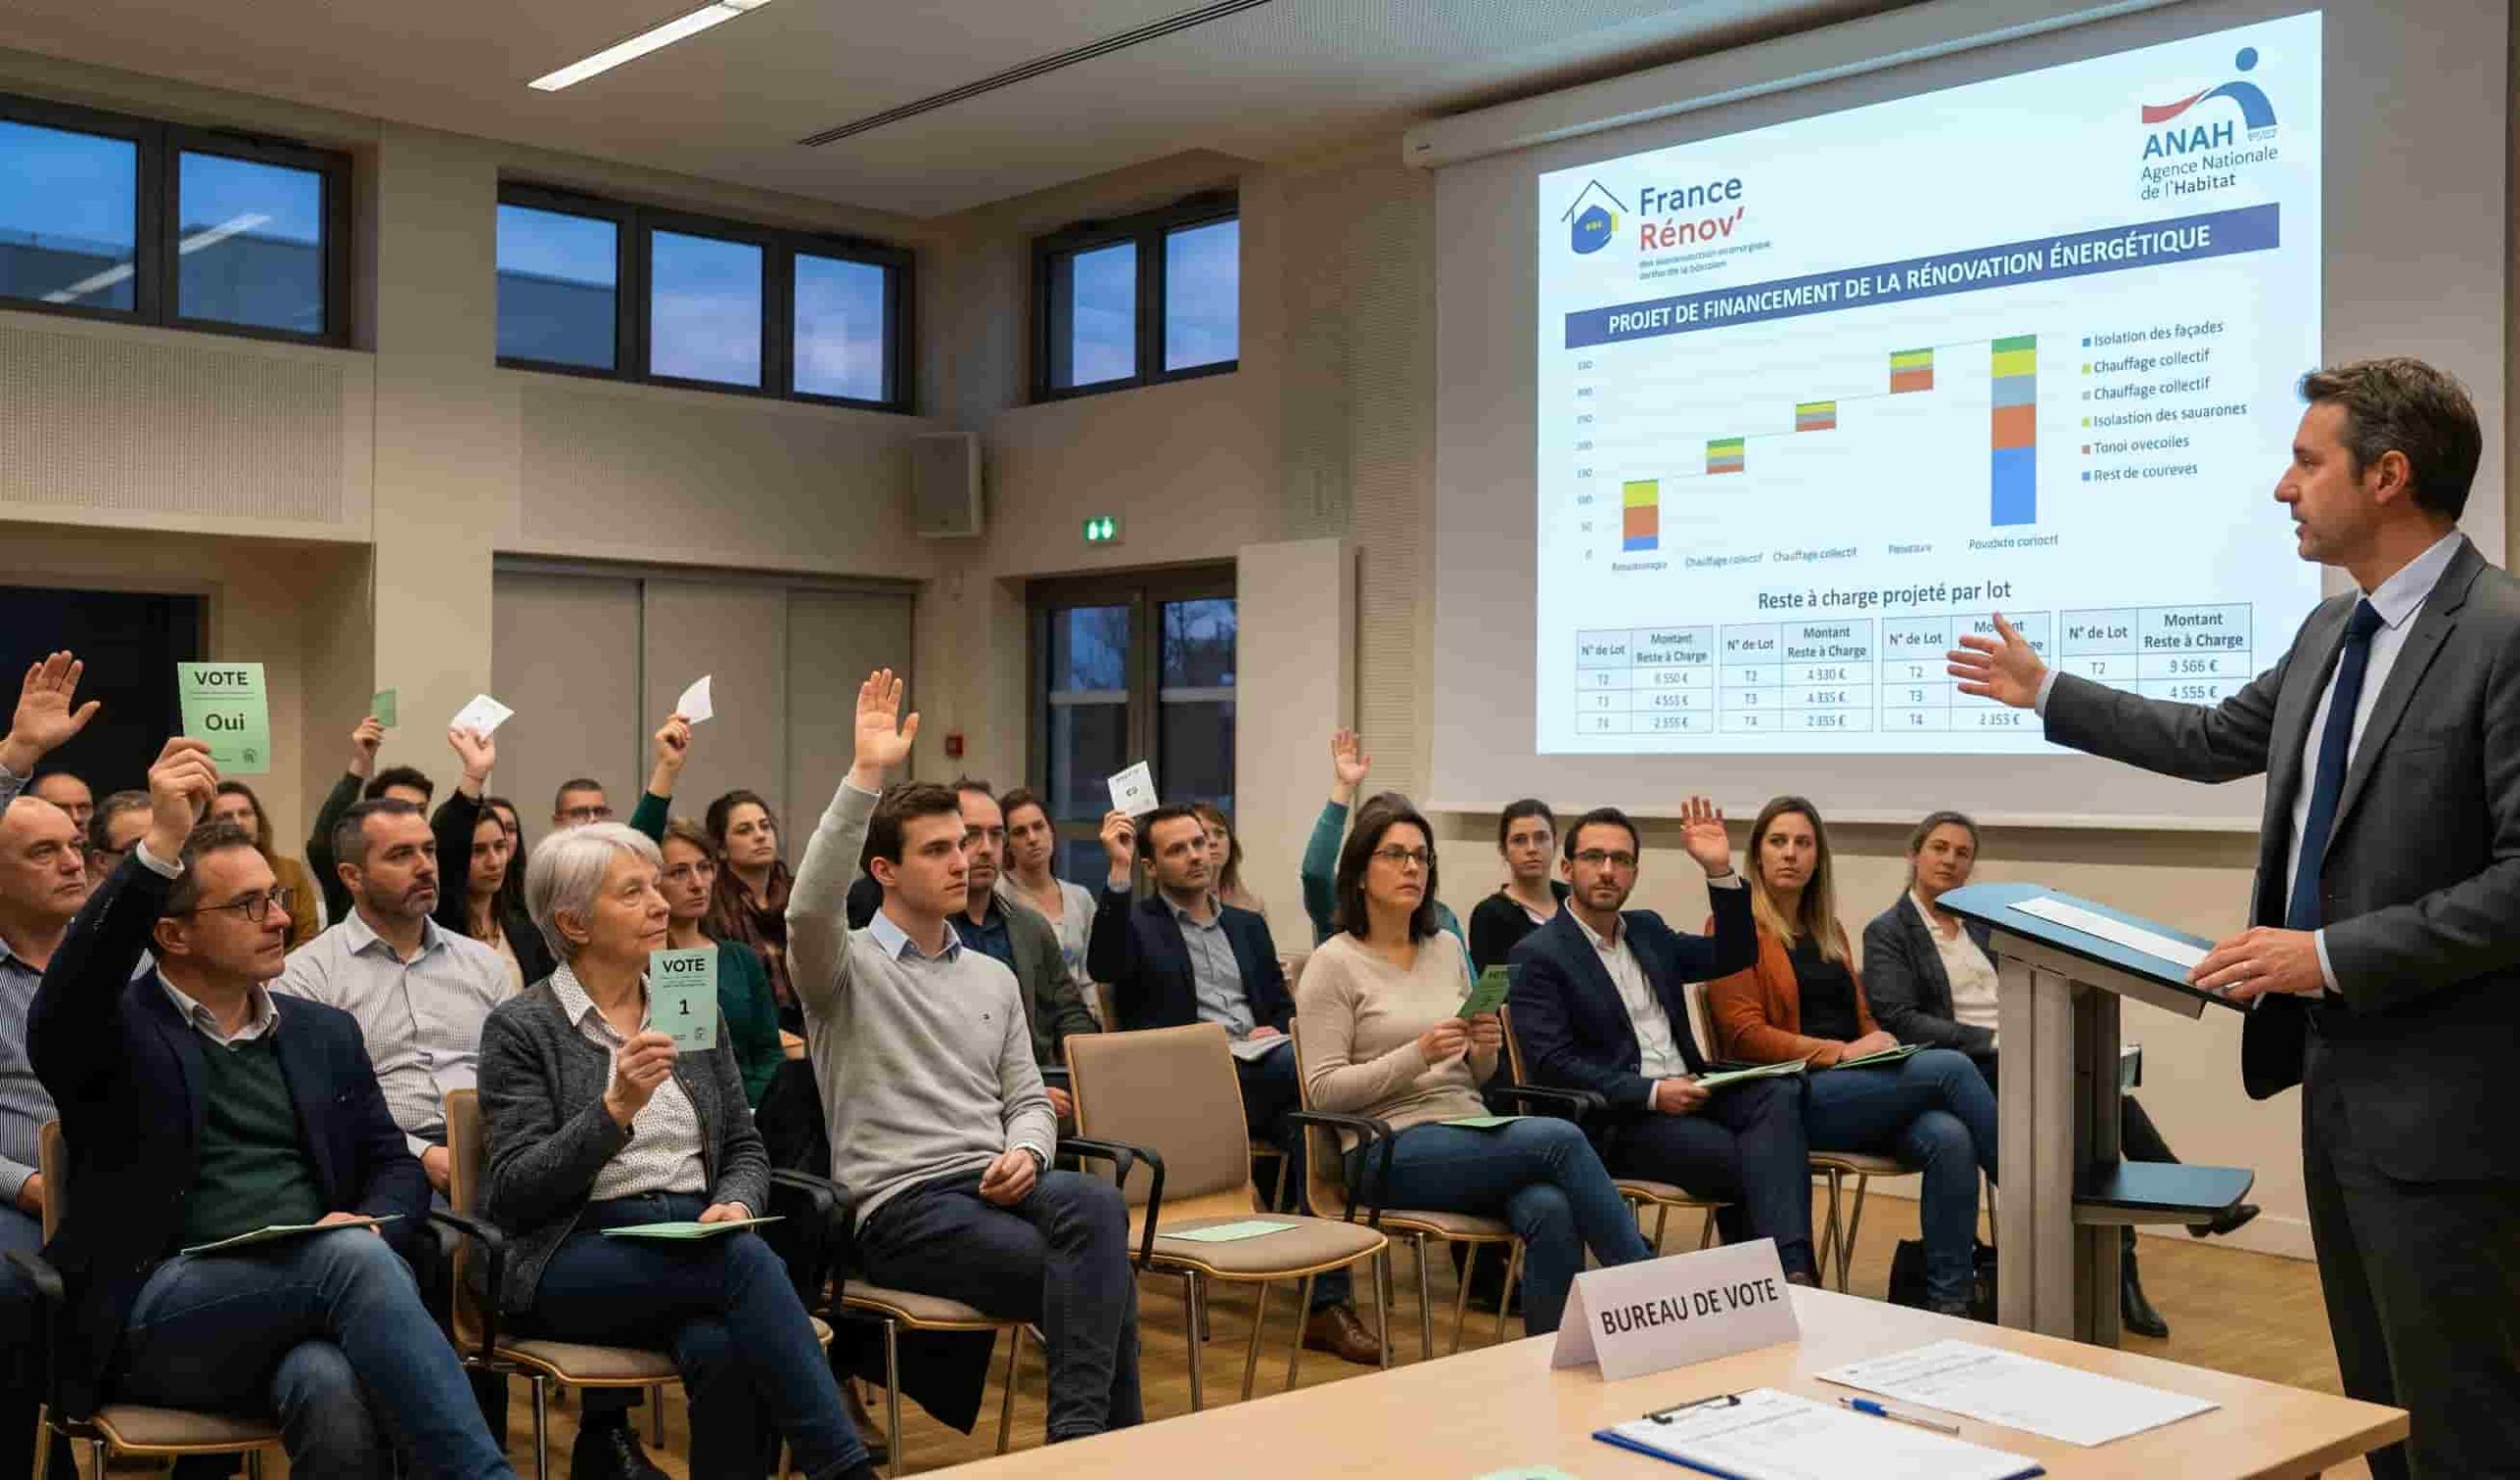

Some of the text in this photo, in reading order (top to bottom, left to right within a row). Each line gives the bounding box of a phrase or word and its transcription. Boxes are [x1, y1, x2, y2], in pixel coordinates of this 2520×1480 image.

[2143, 120, 2234, 160] ANAH
[2141, 146, 2279, 183] Agence Nationale
[1640, 177, 1743, 216] France
[2141, 185, 2160, 201] de
[1640, 206, 1745, 251] Rénov'
[1607, 224, 2211, 335] PROJET DE FINANCEMENT DE LA RÉNOVATION ÉNERGÉTIQUE
[2094, 320, 2224, 347] Isolation des façades
[2094, 347, 2211, 373] Chauffage collectif
[2094, 375, 2212, 400] Chauffage collectif
[2155, 407, 2177, 422] des
[2123, 465, 2139, 479] de
[1758, 580, 2012, 610] Reste à charge projeté par lot
[1974, 620, 2025, 633] Mont
[2164, 612, 2224, 627] Montant
[1803, 627, 1852, 639] Montant
[1906, 633, 1921, 645] de
[1923, 632, 1943, 645] Lot
[2087, 625, 2105, 639] de
[2107, 625, 2129, 639] Lot
[1741, 639, 1757, 650] de
[1758, 639, 1774, 650] Lot
[2144, 633, 2244, 649] Reste à Charge
[1788, 645, 1867, 658] Reste à Charge
[1908, 666, 1924, 679] T2
[2090, 661, 2107, 676] T2
[194, 671, 249, 686] VOTE
[205, 712, 245, 731] Oui
[662, 957, 706, 973] VOTE
[679, 999, 691, 1016] 1
[1601, 1277, 1779, 1335] BUREAU DE VOTE
